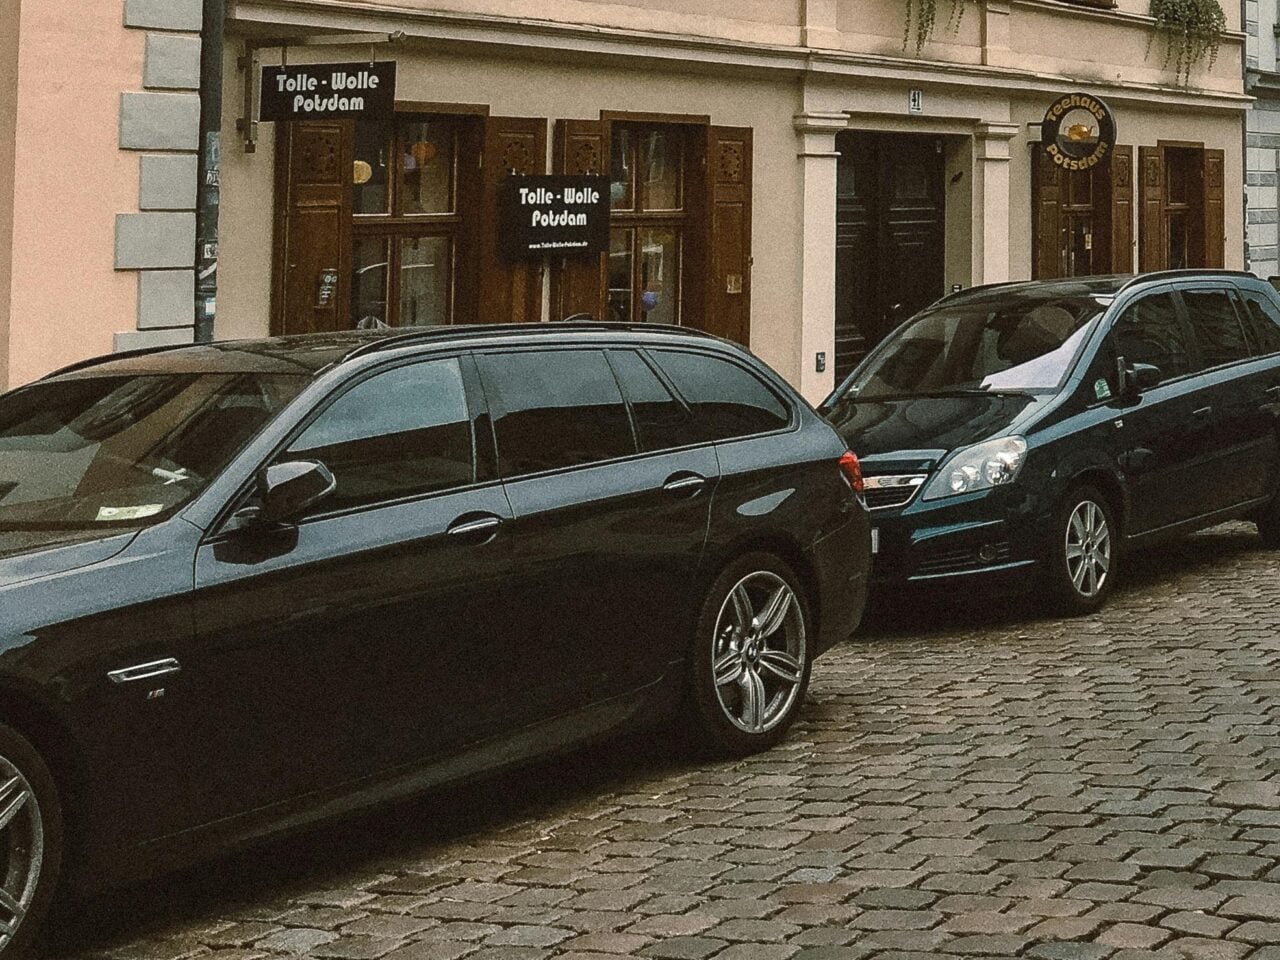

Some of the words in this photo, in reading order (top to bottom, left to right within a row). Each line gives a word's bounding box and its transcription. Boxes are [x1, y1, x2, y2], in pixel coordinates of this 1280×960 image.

[276, 74, 317, 92] Tolle
[331, 71, 380, 90] Wolle
[293, 94, 364, 112] Potsdam
[1046, 95, 1106, 122] Teehaus
[1046, 141, 1108, 170] Potsdam
[519, 187, 554, 205] Tolle
[564, 187, 600, 204] Wolle
[531, 210, 587, 227] Potsdam
